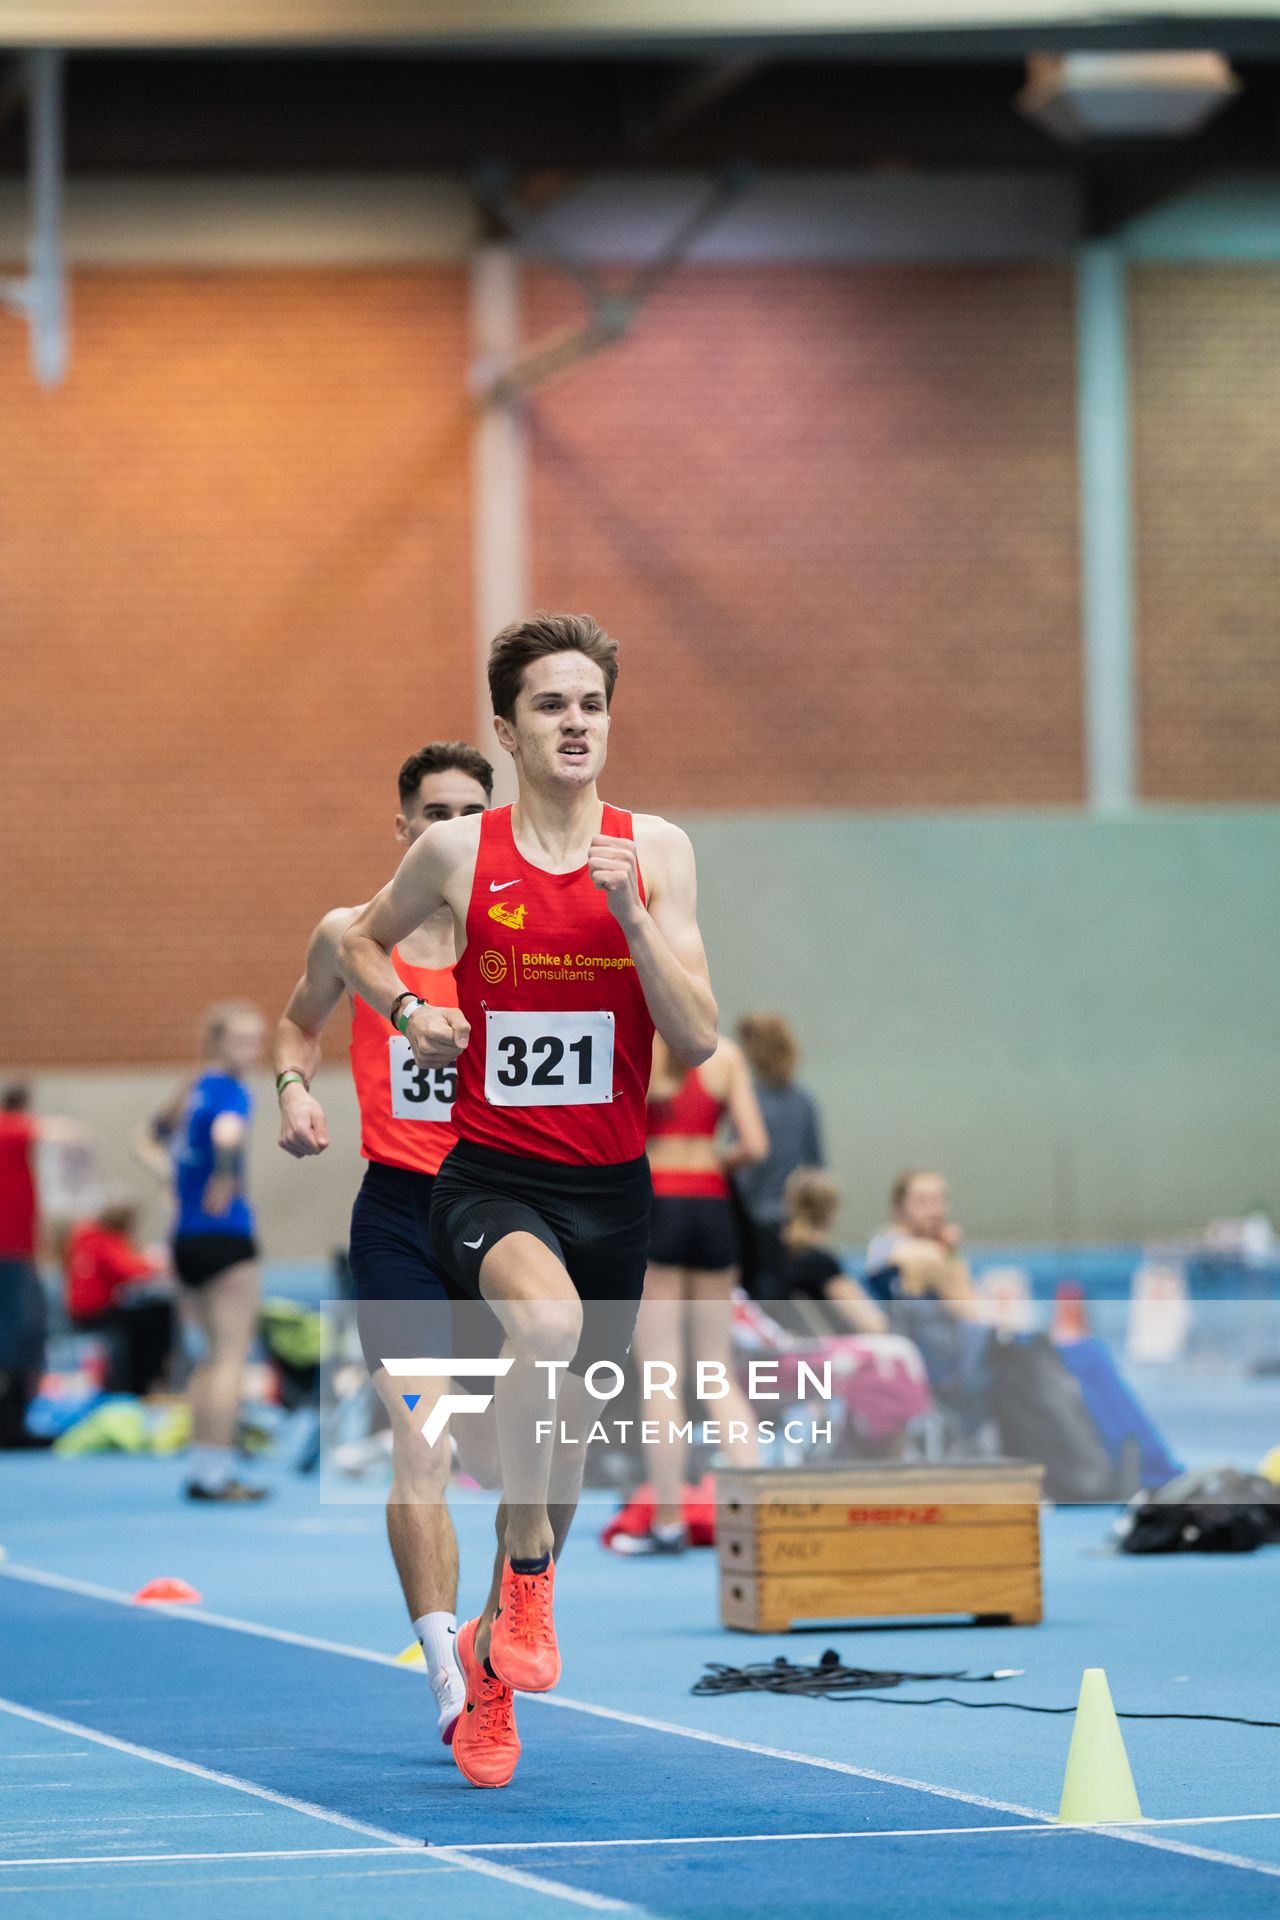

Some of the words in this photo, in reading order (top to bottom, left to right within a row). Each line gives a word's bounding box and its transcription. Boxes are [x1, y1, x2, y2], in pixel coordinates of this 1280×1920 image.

[522, 953, 561, 965] Böhke
[563, 954, 572, 966] &
[523, 968, 595, 981] Consultants
[497, 1035, 592, 1087] 321
